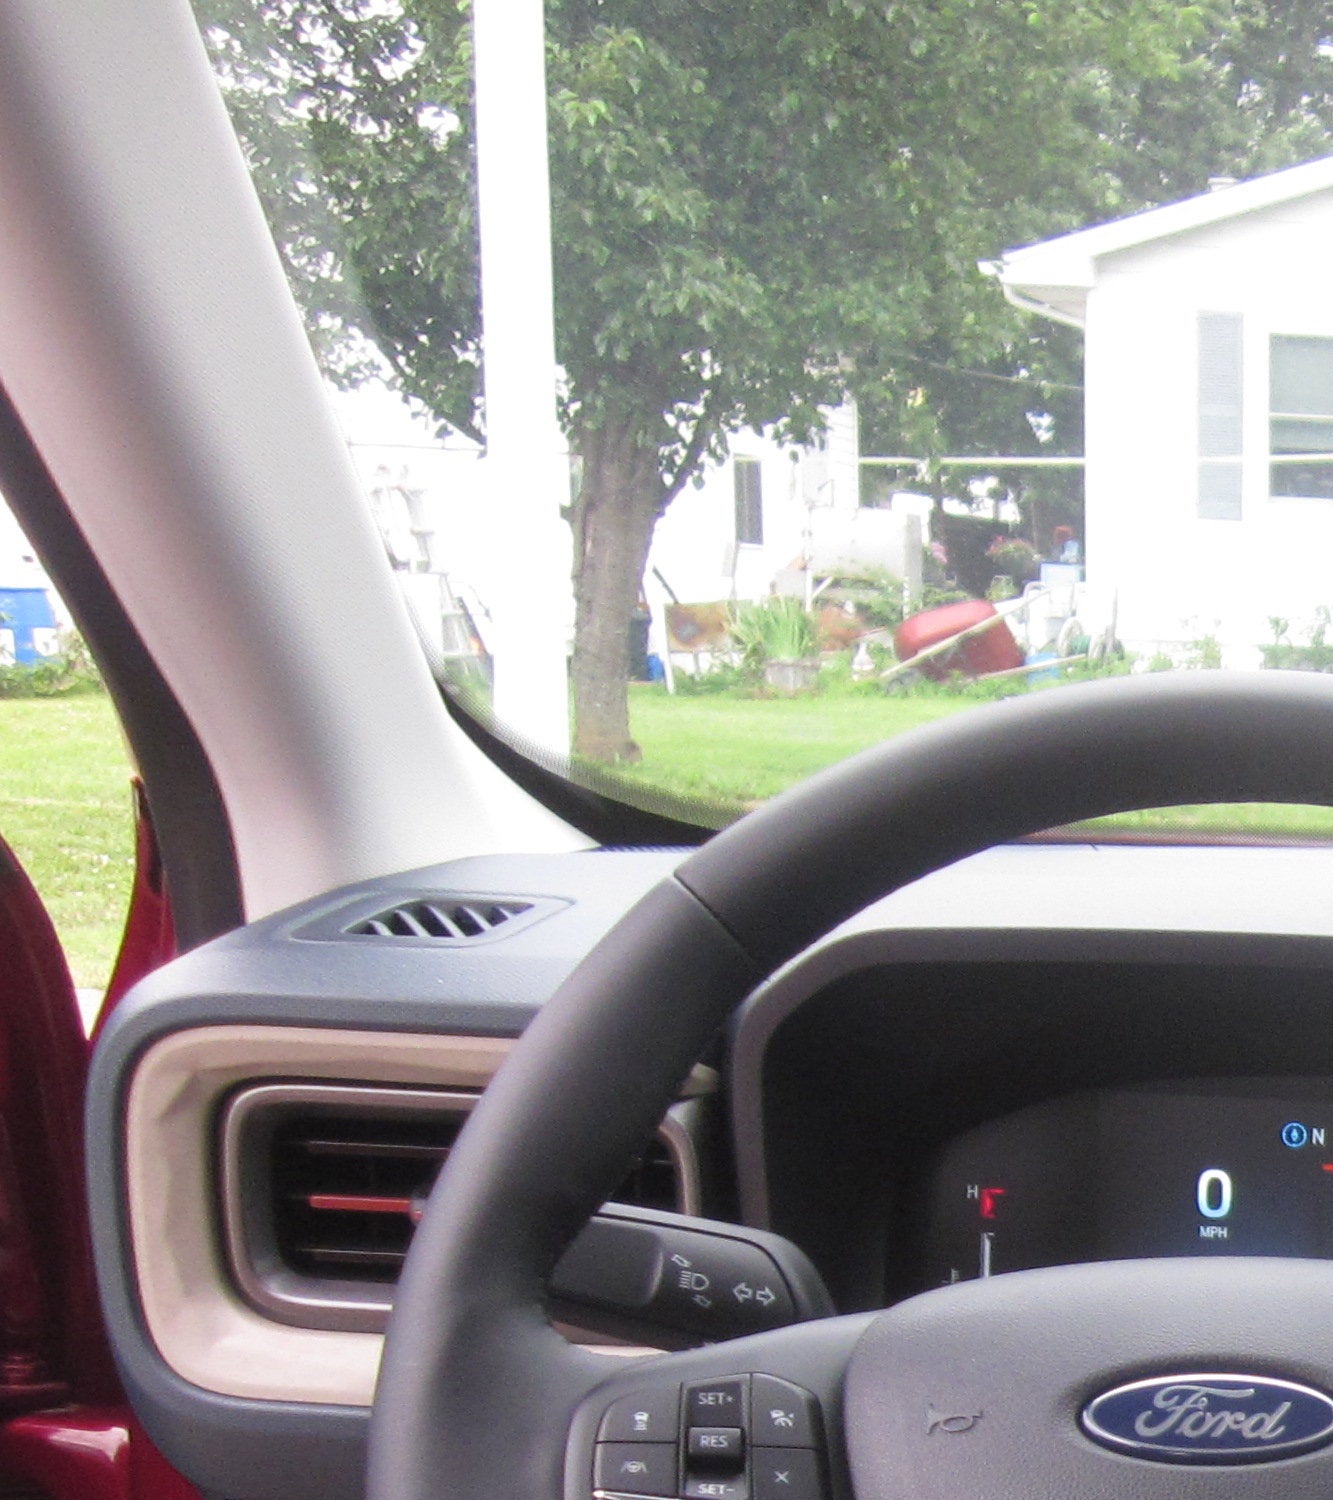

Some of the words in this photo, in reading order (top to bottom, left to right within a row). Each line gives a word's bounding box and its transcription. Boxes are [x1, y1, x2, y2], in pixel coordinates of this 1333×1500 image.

[1311, 1127, 1326, 1146] N
[966, 1184, 979, 1200] H
[1197, 1168, 1233, 1218] 0
[1199, 1225, 1228, 1239] MPH
[1134, 1384, 1292, 1440] Ford
[700, 1435, 728, 1448] RES
